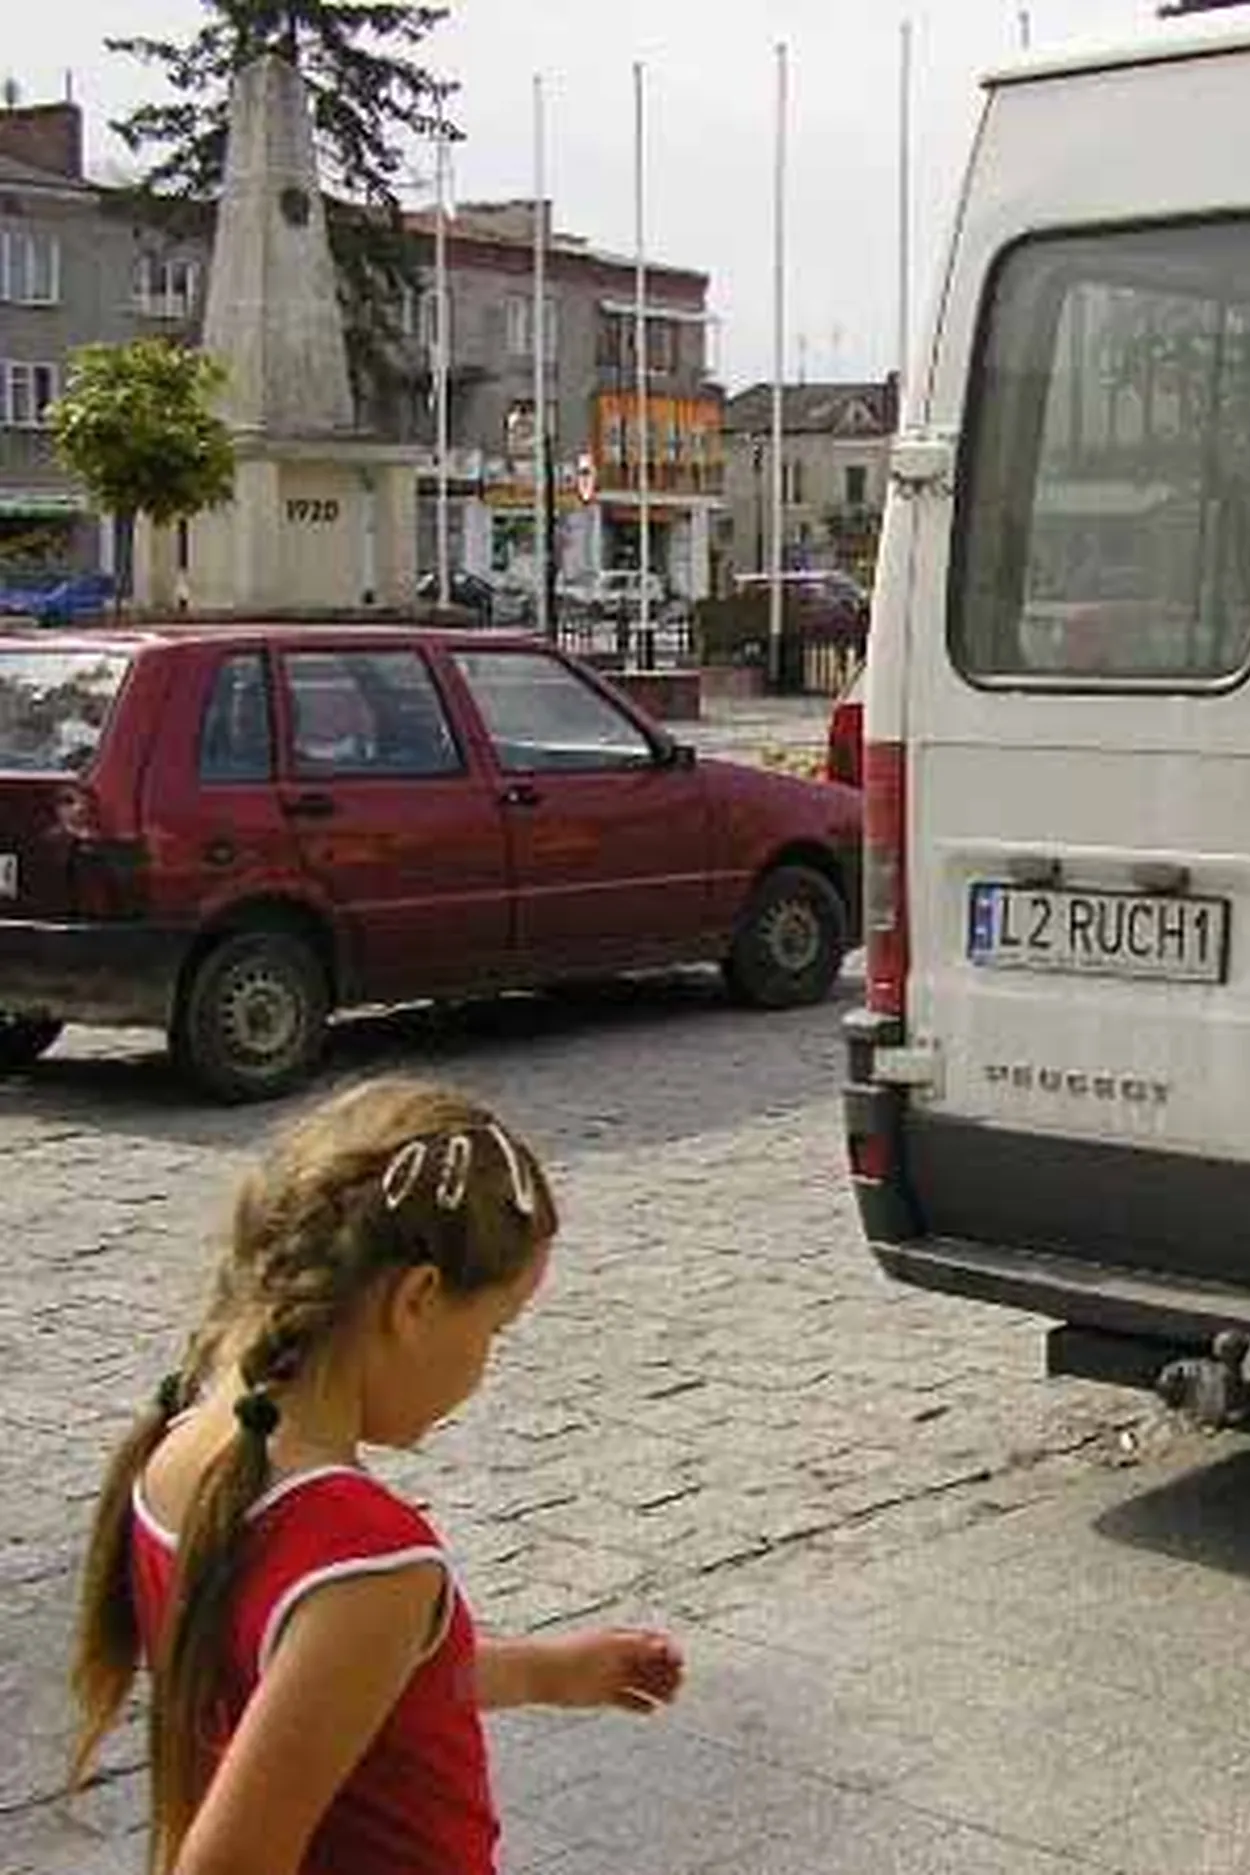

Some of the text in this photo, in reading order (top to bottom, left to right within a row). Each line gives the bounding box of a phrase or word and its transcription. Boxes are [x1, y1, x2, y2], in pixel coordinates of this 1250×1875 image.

[286, 498, 338, 521] 1920
[1000, 895, 1210, 963] L2 RUCH1
